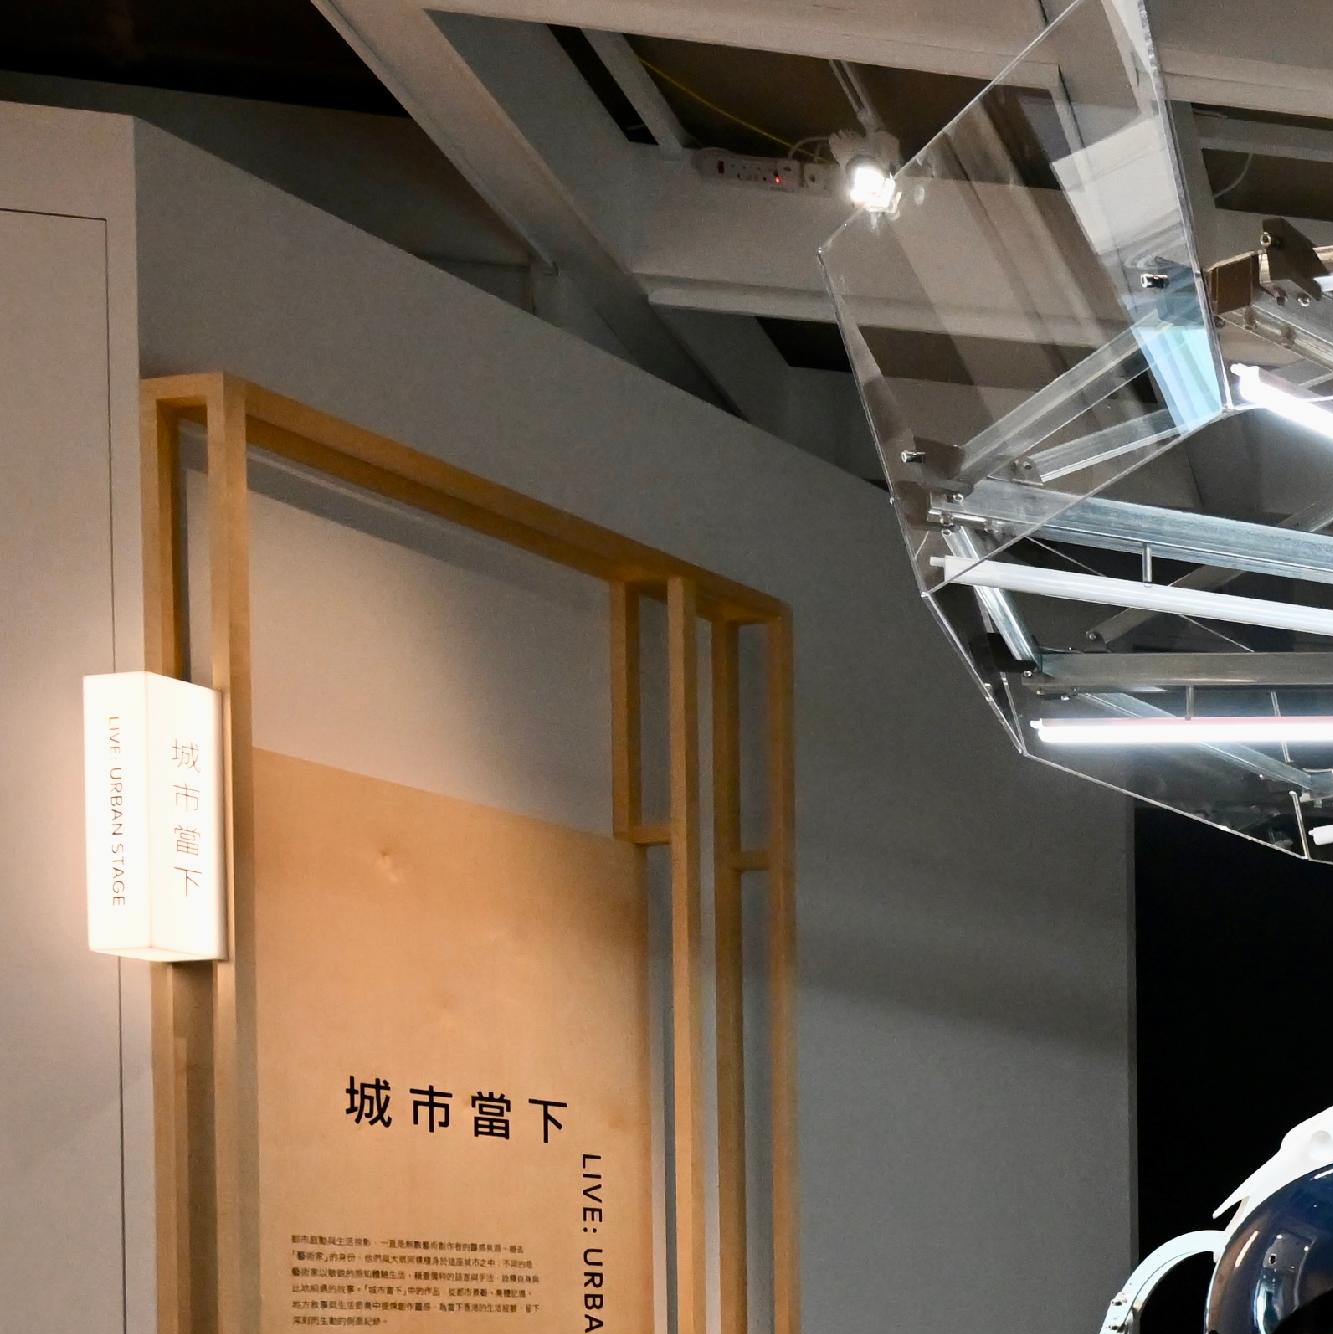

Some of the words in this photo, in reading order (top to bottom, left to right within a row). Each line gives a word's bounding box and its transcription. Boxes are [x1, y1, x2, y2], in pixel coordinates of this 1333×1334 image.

[109, 767, 123, 836] URBAN
[111, 843, 126, 906] STAGE
[345, 1075, 568, 1143] 城市當下
[582, 1153, 603, 1233] LIVE:
